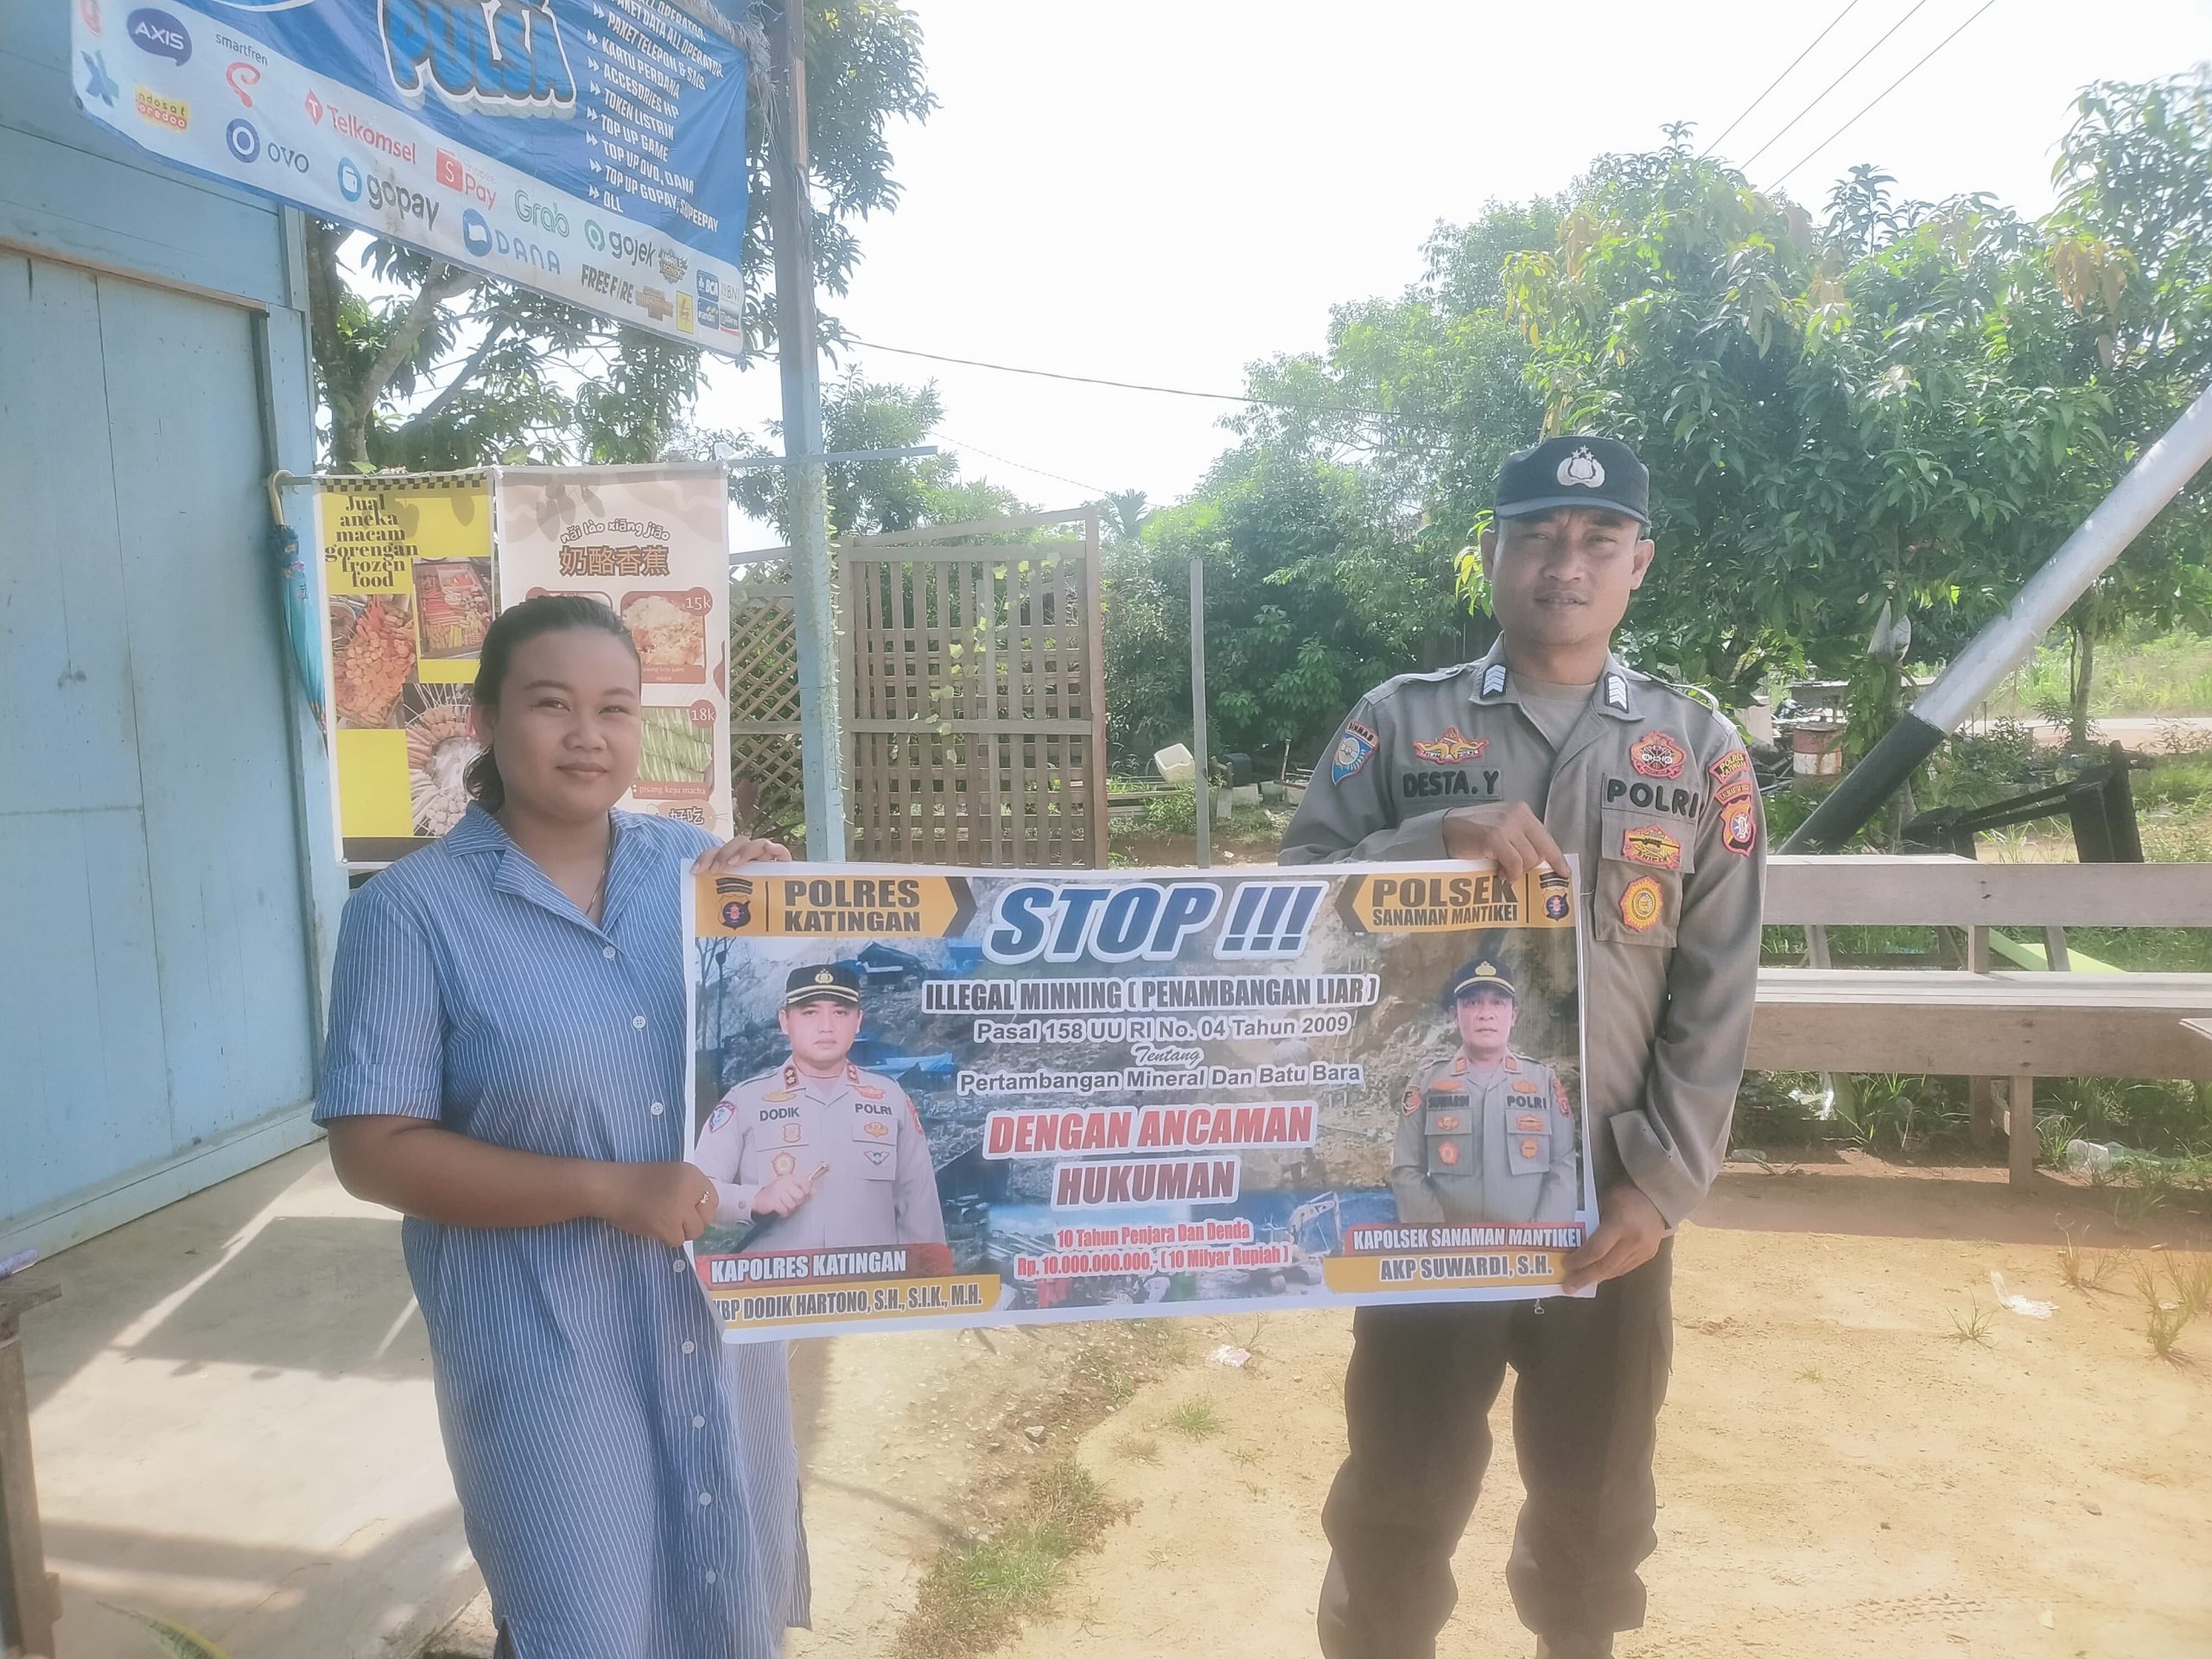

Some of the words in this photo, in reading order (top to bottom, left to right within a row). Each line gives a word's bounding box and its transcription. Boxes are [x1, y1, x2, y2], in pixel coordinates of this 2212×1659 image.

[135, 22, 184, 50] AXIS
[215, 32, 269, 67] smartfren
[643, 9, 666, 39] DATA
[666, 27, 682, 50] ALL
[681, 38, 724, 78] OPERATOR
[607, 11, 639, 45] PAKET
[637, 33, 677, 73] TELEPON
[677, 61, 686, 78] &
[687, 66, 706, 91] SMS
[601, 36, 636, 71] KARTU
[637, 58, 681, 99] PERDANA
[138, 92, 185, 116] ndosat
[603, 62, 663, 113] ACCESORIES
[663, 100, 680, 119] HP
[605, 88, 633, 121] TOKEN
[634, 108, 675, 141] LISTRIK
[327, 104, 416, 164] Telkomsel
[601, 113, 620, 137] TOP
[622, 125, 639, 145] UP
[640, 134, 669, 162] GAME
[601, 139, 625, 162] TOP
[626, 150, 639, 169] UP
[664, 170, 695, 196] DANA
[605, 164, 623, 188] TOP
[625, 175, 638, 194] UP
[366, 173, 440, 231] gopay
[465, 172, 497, 211] Pay
[604, 191, 624, 213] DLL
[514, 189, 570, 238] Grab
[608, 230, 657, 267] gojek
[581, 264, 611, 295] FREE
[705, 280, 719, 300] BCA
[727, 284, 741, 302] BNI
[340, 503, 399, 527] aneka
[346, 493, 385, 512] Jual
[336, 529, 405, 542] macam
[325, 542, 418, 563] gorengan
[342, 554, 405, 572] frozen
[559, 544, 671, 576] 奶酪香蕉
[353, 569, 394, 588] food
[685, 594, 711, 610] 15k
[690, 708, 715, 721] 18k
[1719, 753, 1745, 772] POLRES
[639, 786, 663, 795] pisang
[664, 785, 681, 795] keju
[683, 786, 706, 795] macha
[1606, 779, 1699, 818] POLRI
[784, 879, 920, 908] POLRES
[1372, 875, 1519, 907] POLSEK
[785, 909, 921, 932] KATINGAN
[988, 884, 1217, 958] STOP
[1218, 884, 1324, 953] !!!
[1372, 908, 1448, 927] SANAMAN
[1451, 904, 1518, 925] MANTIKEI
[925, 982, 1015, 1011] ILLEGAL
[1020, 981, 1122, 1011] MINNING
[977, 1022, 1038, 1040] Pasal
[1045, 1022, 1084, 1039] 158
[1090, 1021, 1122, 1039] UU
[1130, 1021, 1152, 1039] RI
[1159, 1020, 1194, 1038] No.
[1201, 1020, 1226, 1037] 04
[1232, 1019, 1295, 1036] Tahun
[1301, 1015, 1349, 1034] 2009
[1135, 1046, 1201, 1067] Tentang
[960, 1071, 1119, 1092] Pertambangan
[1127, 1069, 1205, 1088] Mineral
[1211, 1068, 1253, 1085] Dan
[1259, 1066, 1306, 1084] Batu
[1312, 1064, 1360, 1081] Bara
[760, 1107, 800, 1122] DODIK
[855, 1103, 893, 1116] POLRI
[1506, 1095, 1548, 1109] POLRI
[988, 1111, 1132, 1154] DENGAN
[1136, 1105, 1313, 1147] ANCAMAN
[1056, 1160, 1236, 1205] HUKUMAN
[1057, 1229, 1073, 1248] 10
[1076, 1228, 1119, 1248] Tahun
[1122, 1224, 1176, 1247] Penjara
[1178, 1223, 1205, 1243] Dan
[1207, 1221, 1250, 1241] Denda
[1353, 1228, 1429, 1250] KAPOLSEK
[1431, 1227, 1506, 1249] SANAMAN
[1508, 1227, 1582, 1249] MANTIKEI
[711, 1255, 810, 1284] KAPOLRES
[812, 1250, 906, 1276] KATINGAN
[1017, 1256, 1039, 1278] Rp.
[1187, 1247, 1230, 1268] Milyar
[1381, 1258, 1416, 1281] AKP
[1421, 1255, 1514, 1279] SUWARDI,
[1517, 1255, 1553, 1275] S.H.
[744, 1294, 796, 1319] DODIK
[796, 1290, 871, 1316] HARTONO,
[874, 1287, 906, 1312] S.H.,
[950, 1283, 982, 1307] M.H.
